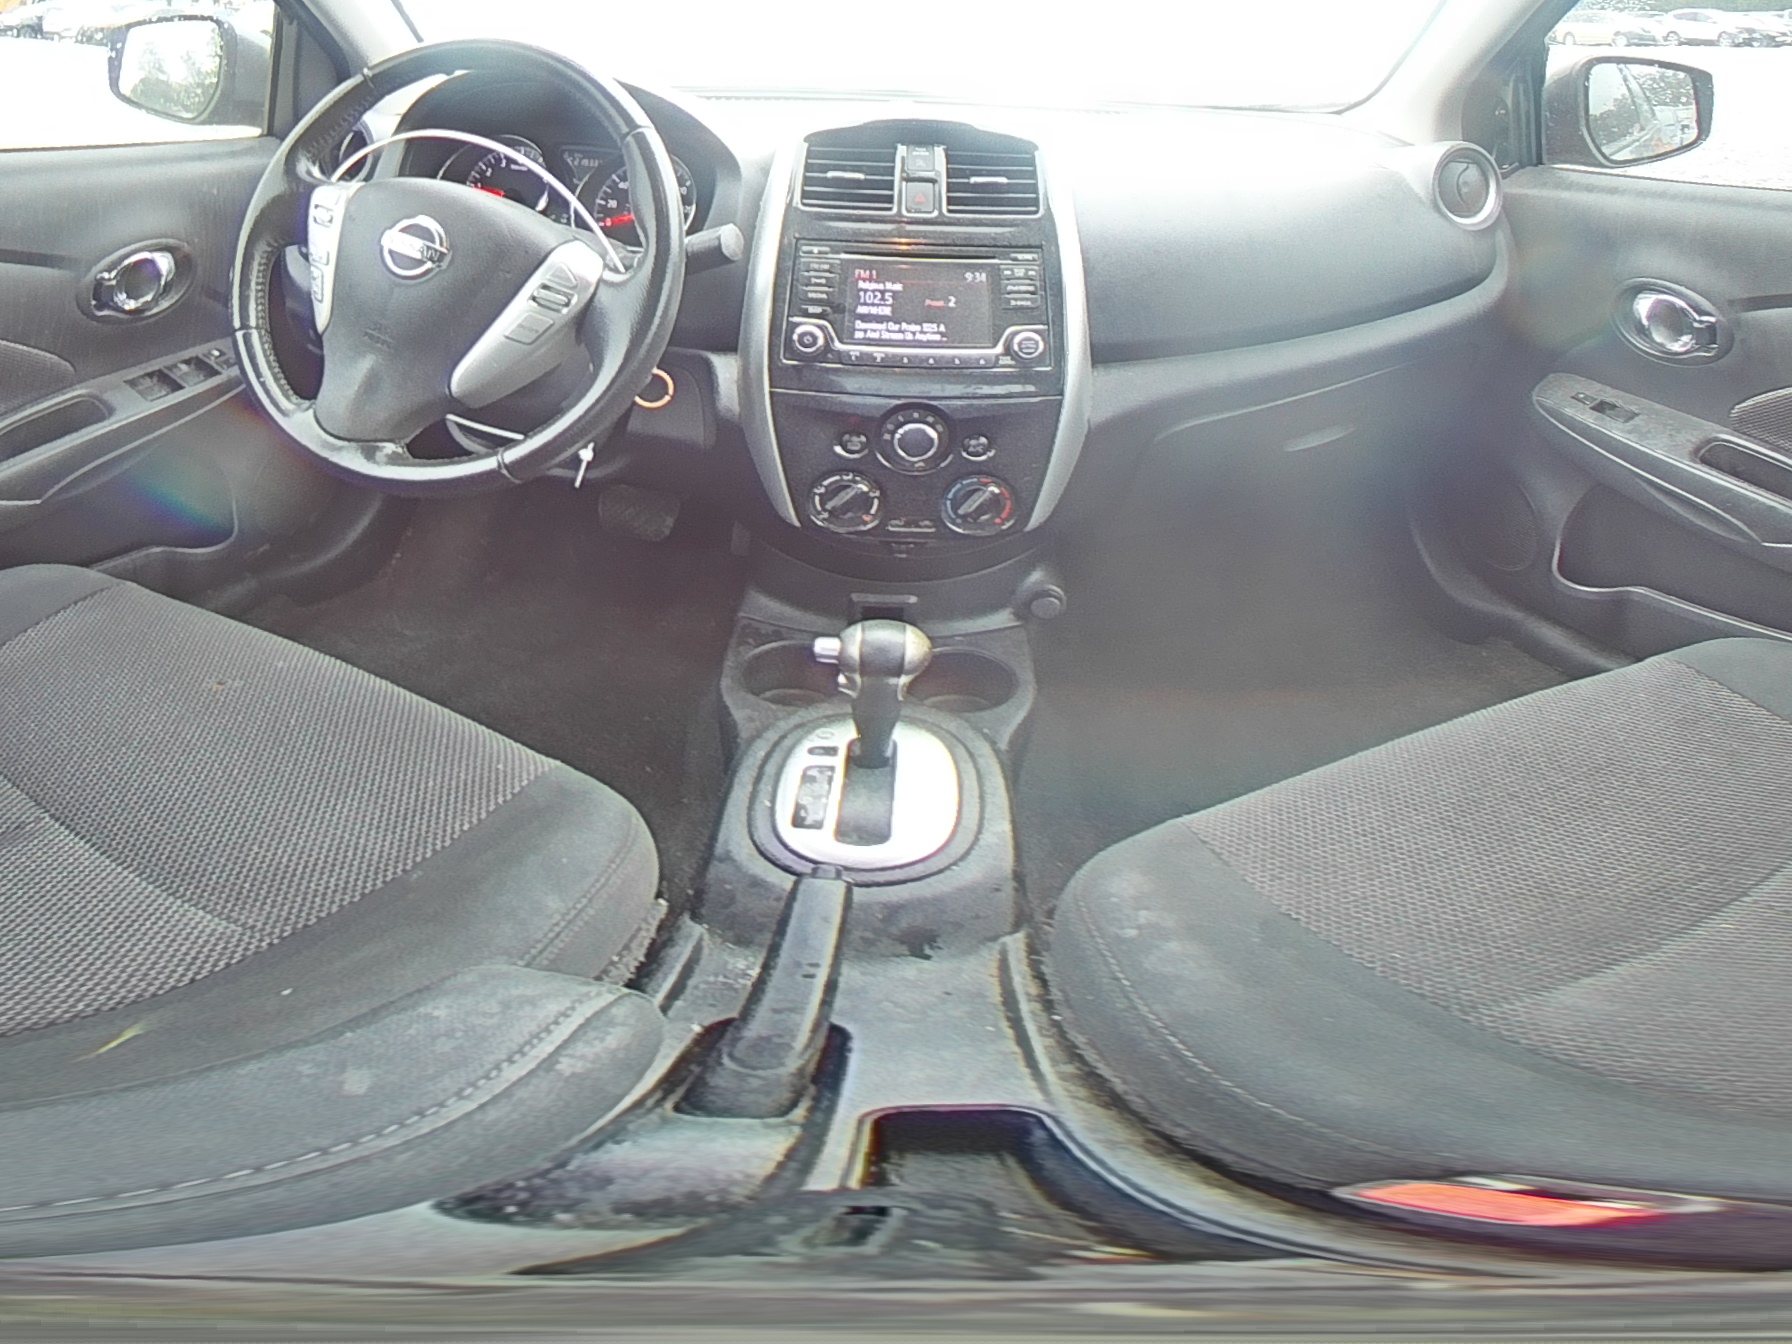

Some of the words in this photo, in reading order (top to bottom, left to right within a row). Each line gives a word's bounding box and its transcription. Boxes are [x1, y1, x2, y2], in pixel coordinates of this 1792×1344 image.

[388, 233, 440, 262] NSSAN
[854, 269, 869, 279] FM
[871, 269, 877, 279] 1
[964, 272, 987, 283] 9:34
[858, 291, 894, 305] 102.5
[948, 296, 957, 308] 2
